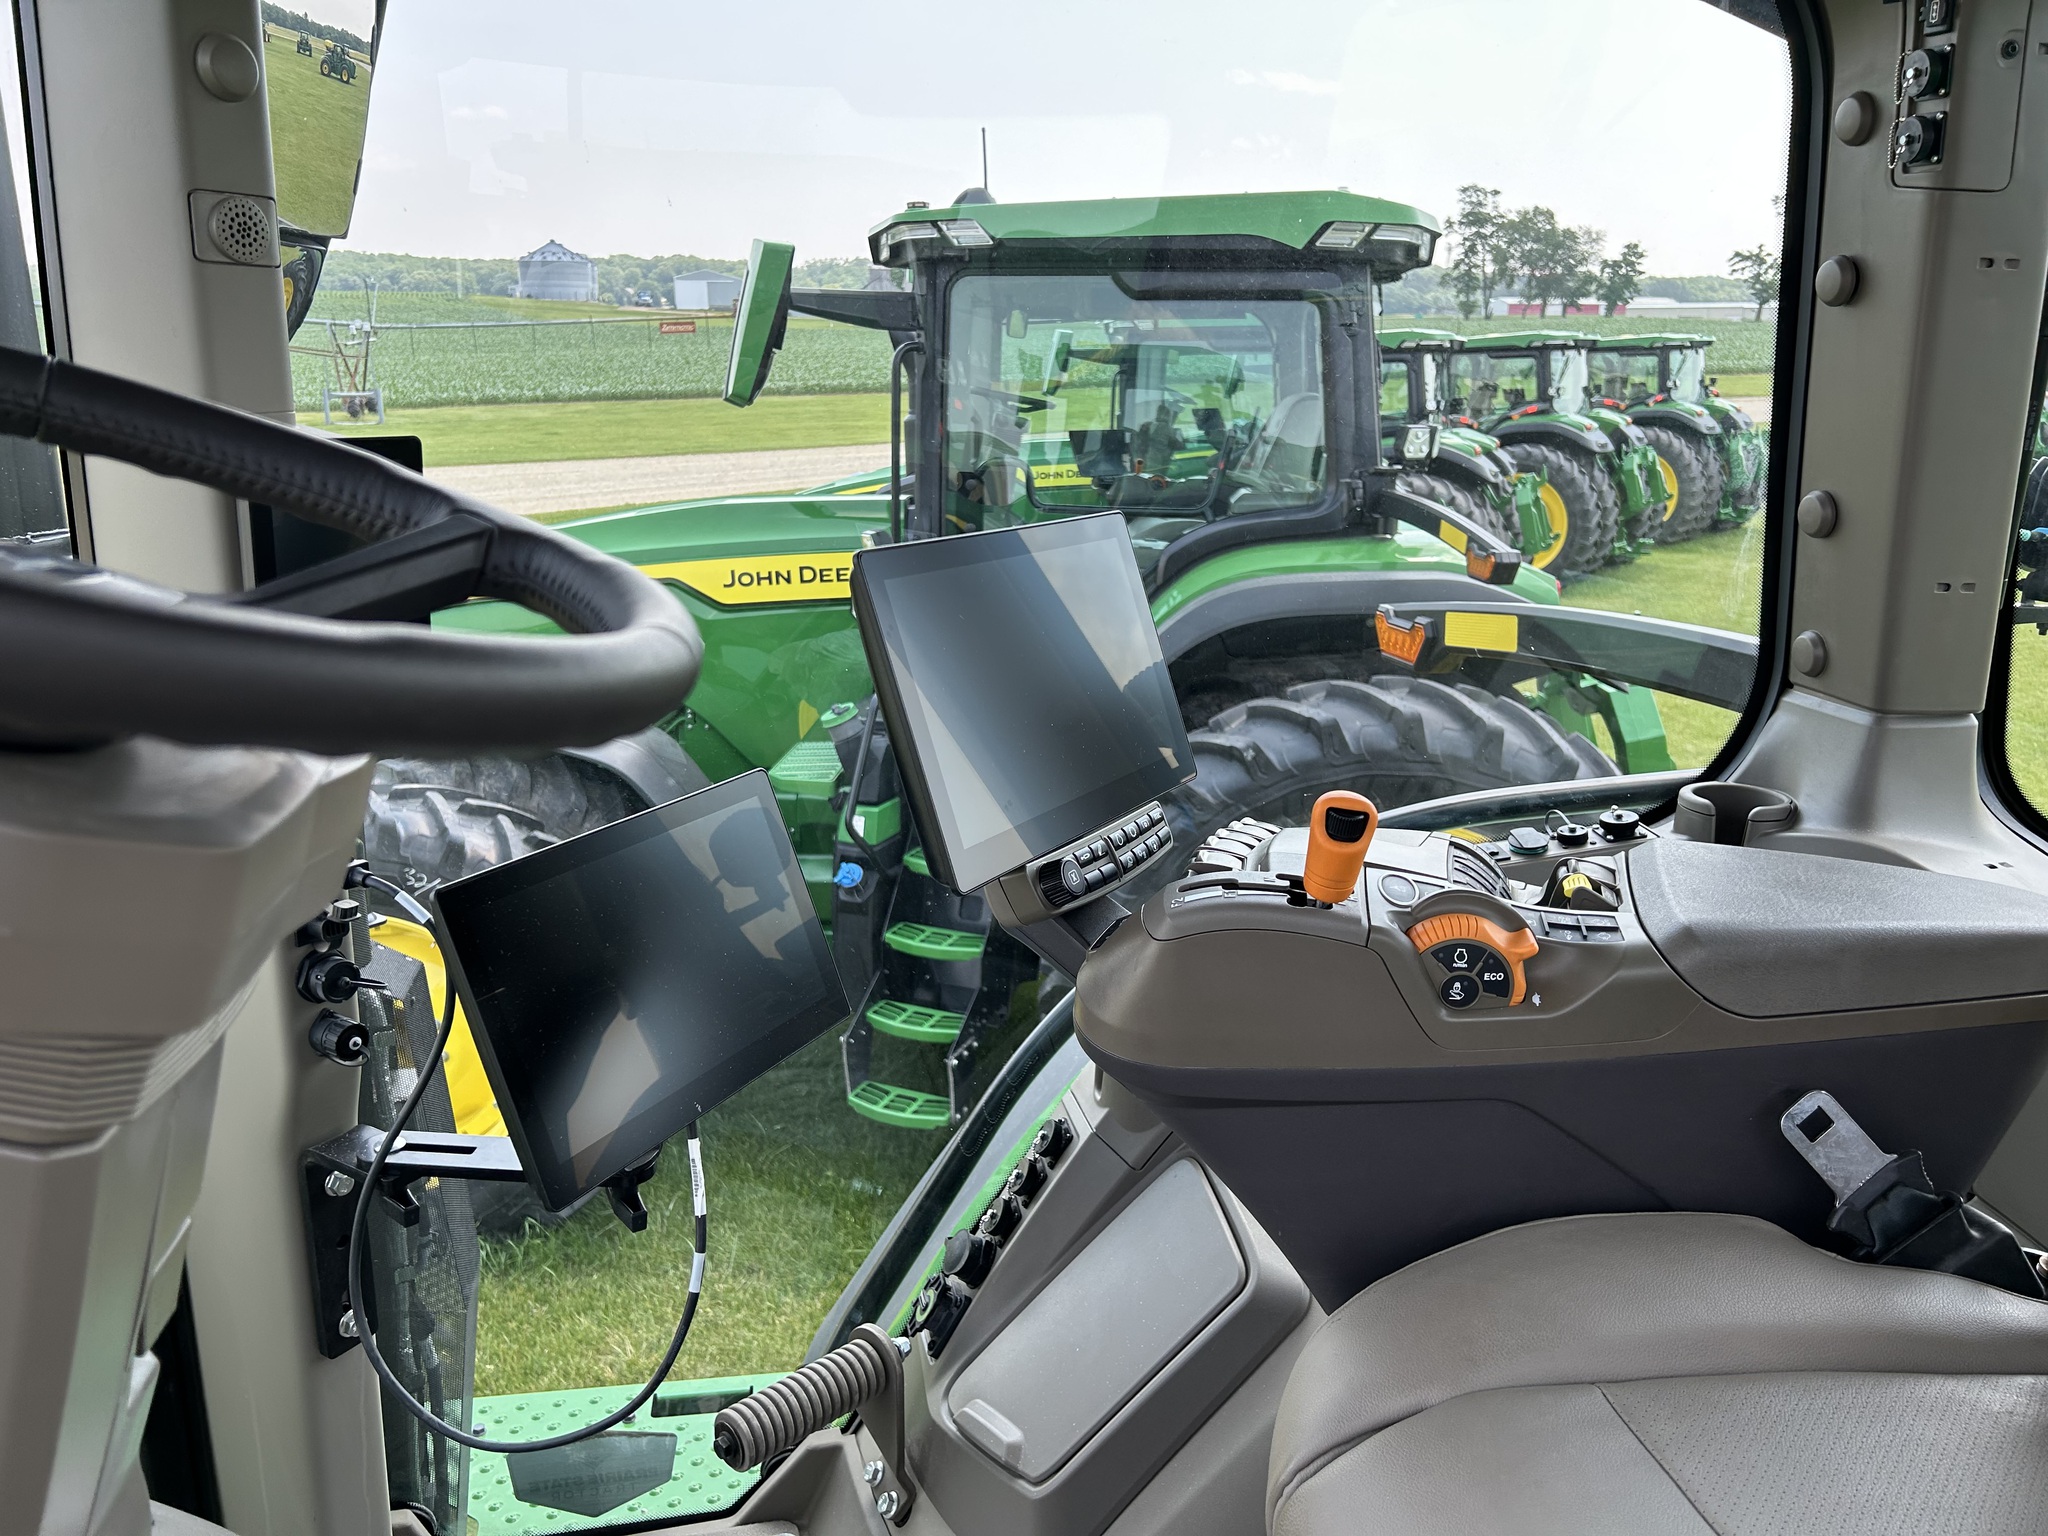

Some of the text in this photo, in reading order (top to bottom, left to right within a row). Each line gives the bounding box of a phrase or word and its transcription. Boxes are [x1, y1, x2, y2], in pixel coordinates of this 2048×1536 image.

[1033, 469, 1081, 480] JOHN DE
[723, 565, 850, 588] JOHN DEE
[1484, 973, 1504, 981] ECO
